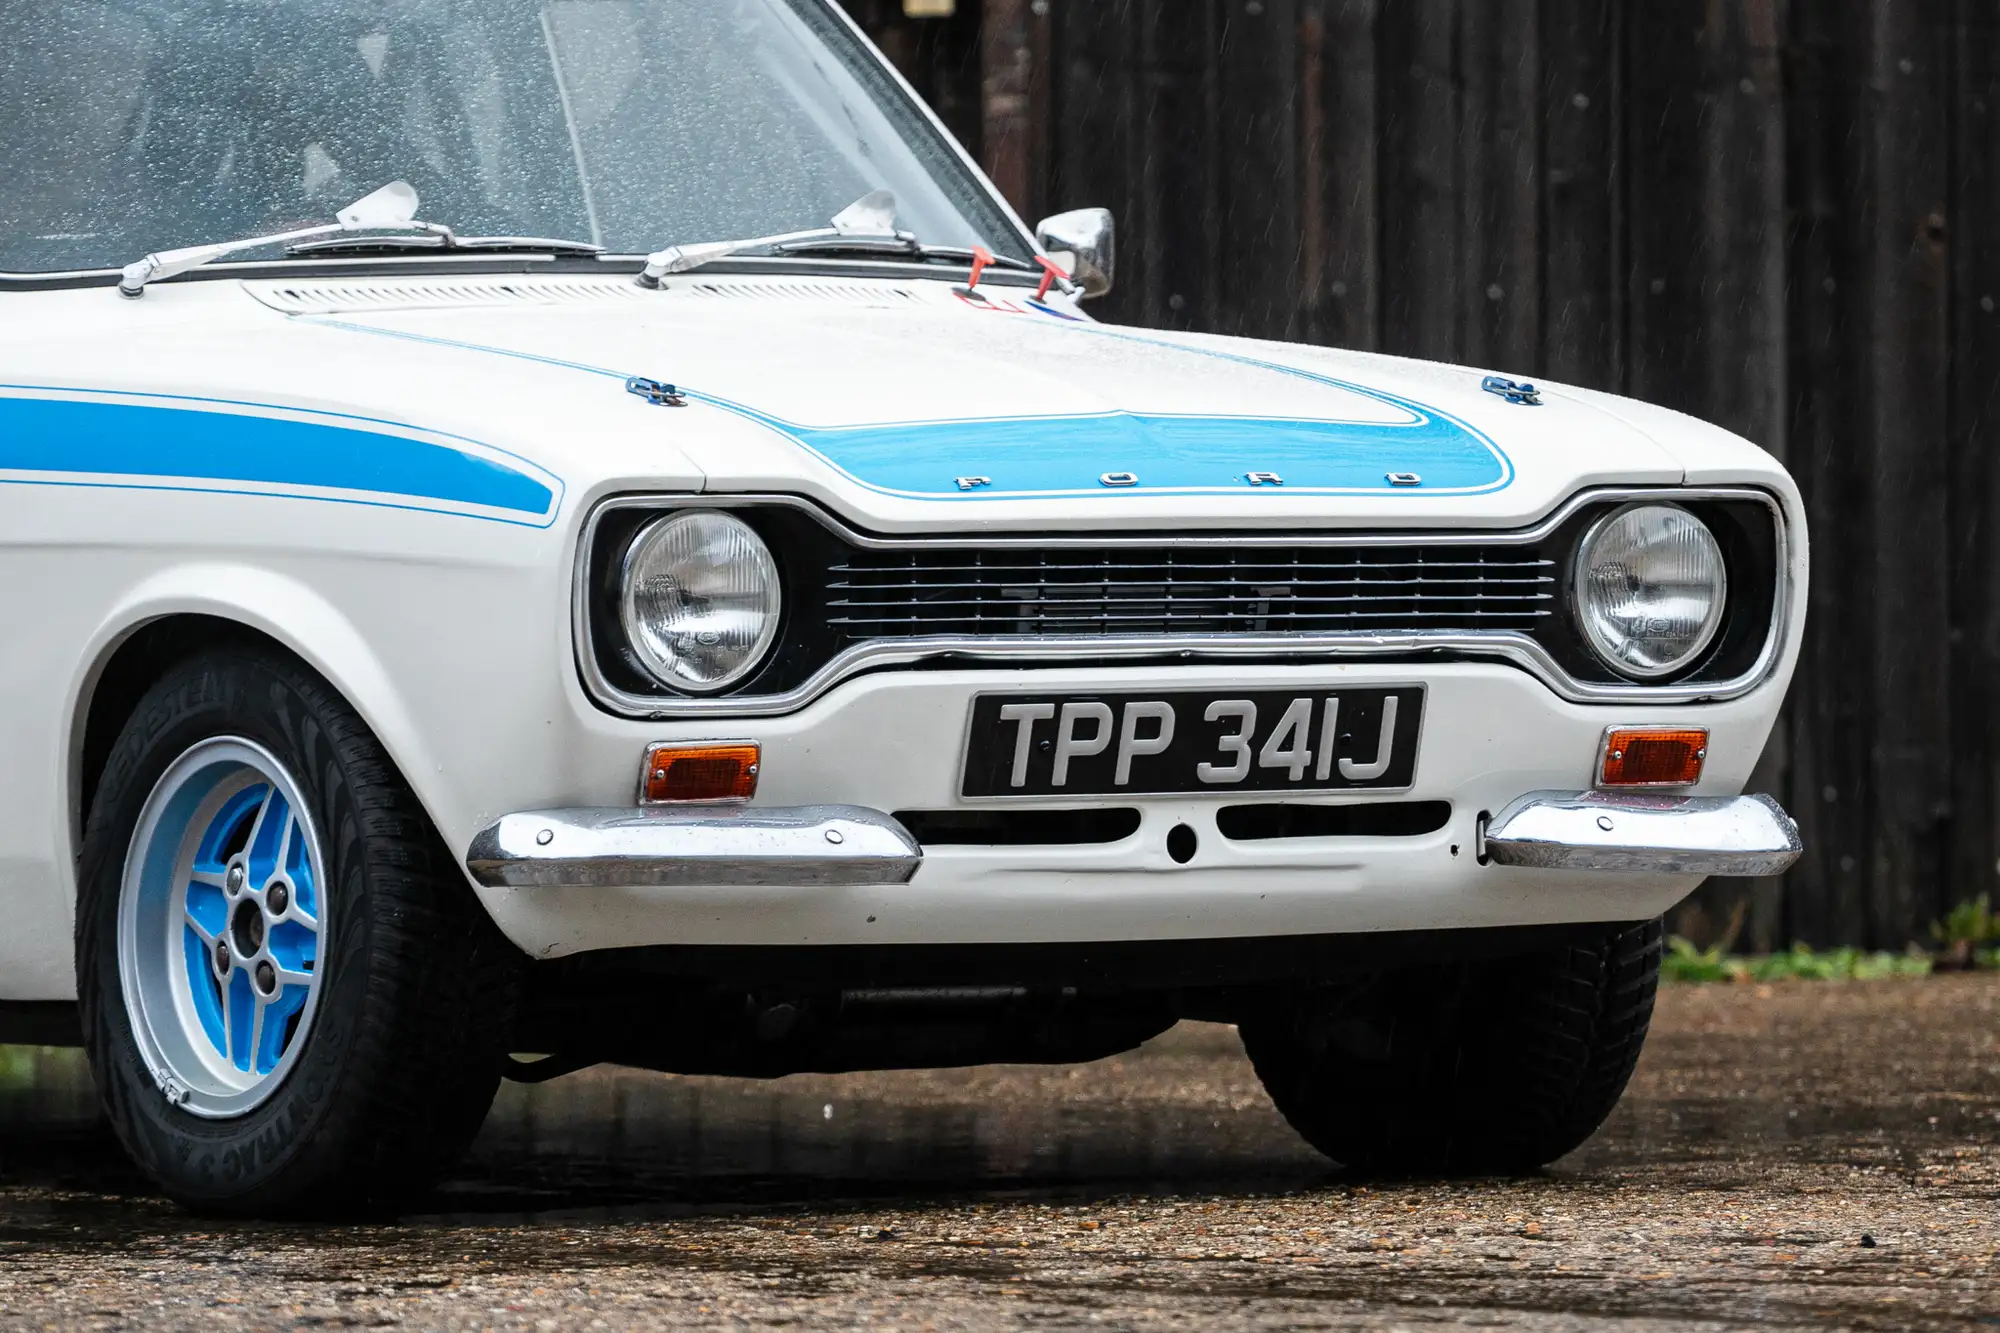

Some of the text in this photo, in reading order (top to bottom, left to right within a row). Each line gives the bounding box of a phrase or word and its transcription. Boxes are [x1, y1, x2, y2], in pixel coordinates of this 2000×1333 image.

[953, 471, 1422, 490] FORD
[1000, 696, 1399, 787] TPP 341J
